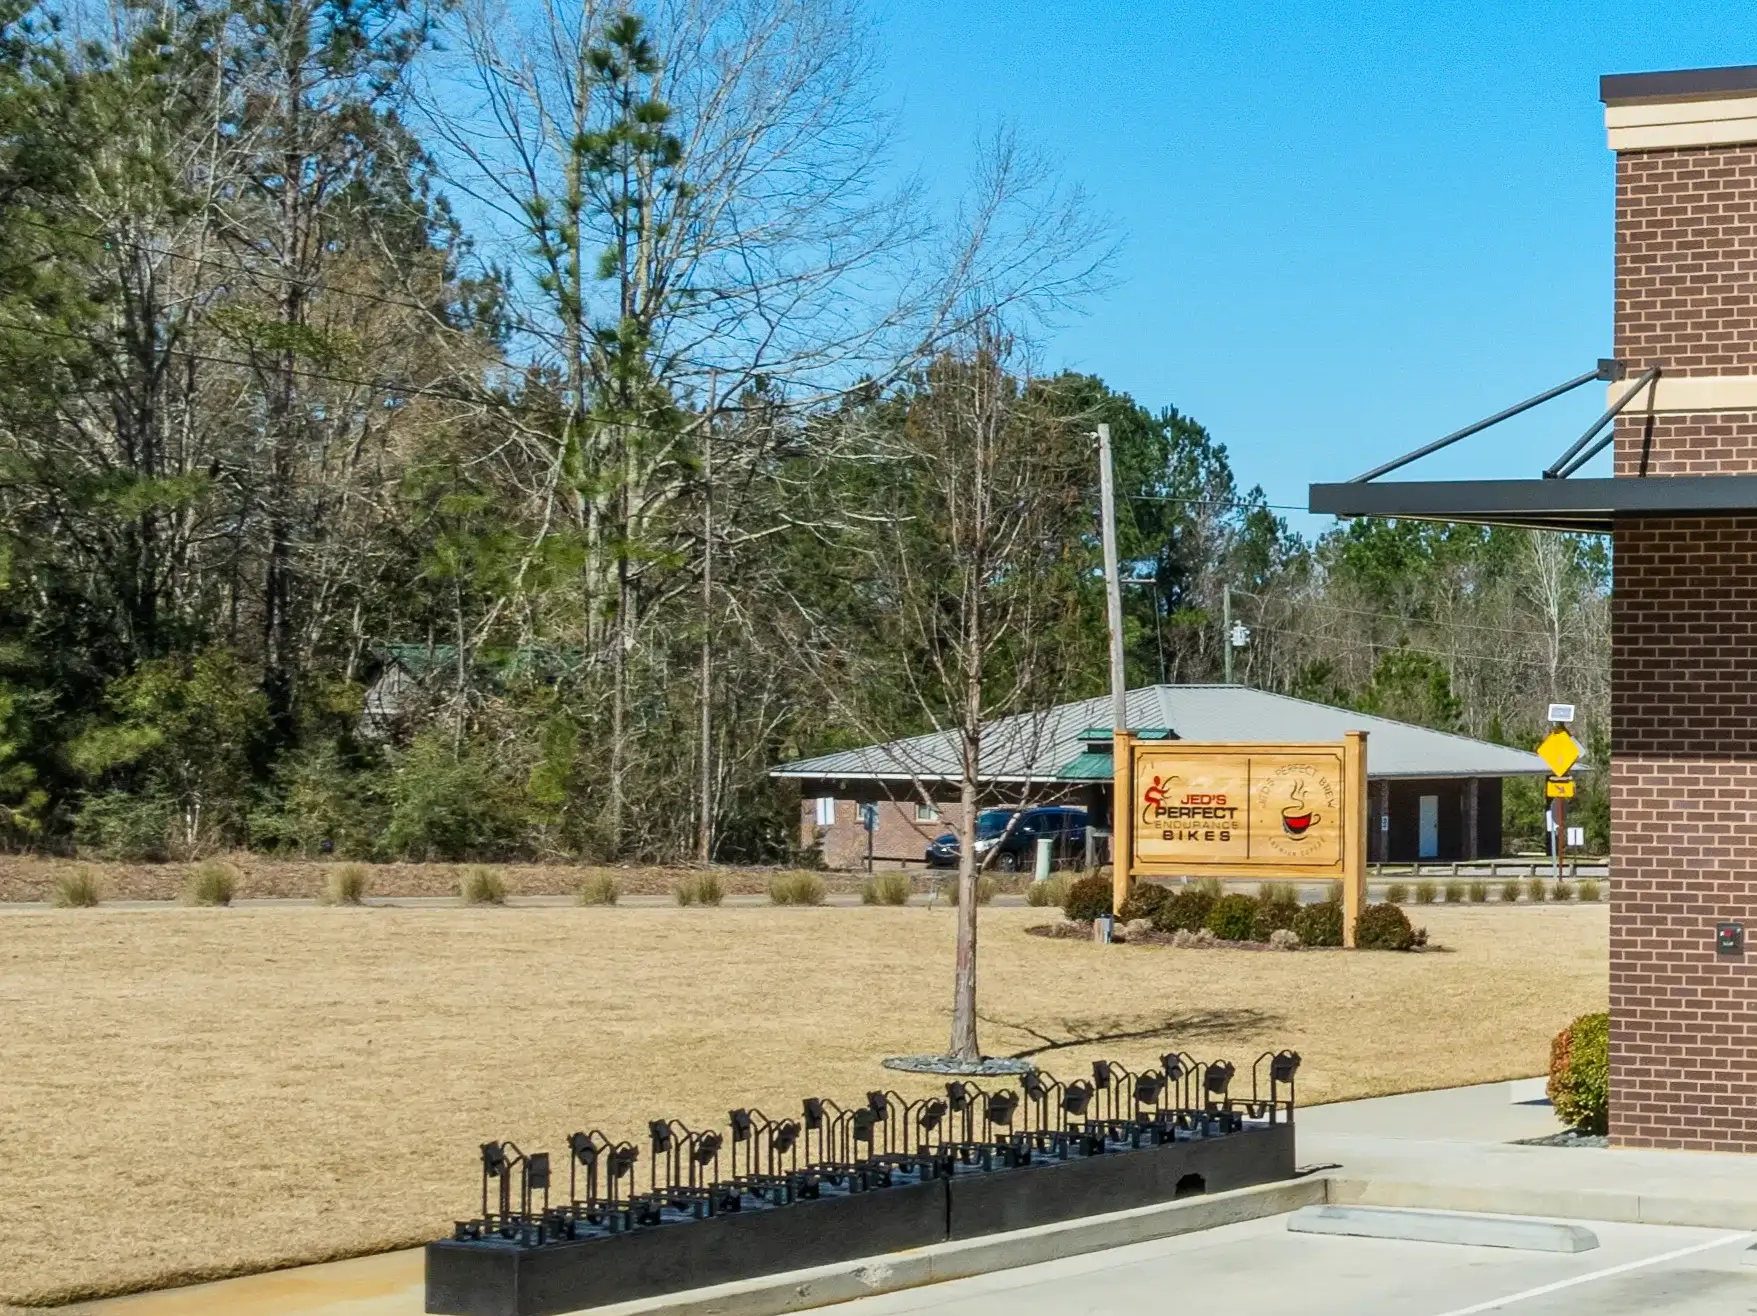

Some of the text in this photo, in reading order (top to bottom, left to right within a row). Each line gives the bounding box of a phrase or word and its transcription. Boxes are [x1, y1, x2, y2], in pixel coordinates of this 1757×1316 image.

[1318, 777, 1336, 809] BREW
[1181, 794, 1227, 805] JED'S
[1155, 806, 1239, 819] PERFECT
[1155, 820, 1240, 830] ENDURANCE
[1162, 830, 1231, 841] BIKES
